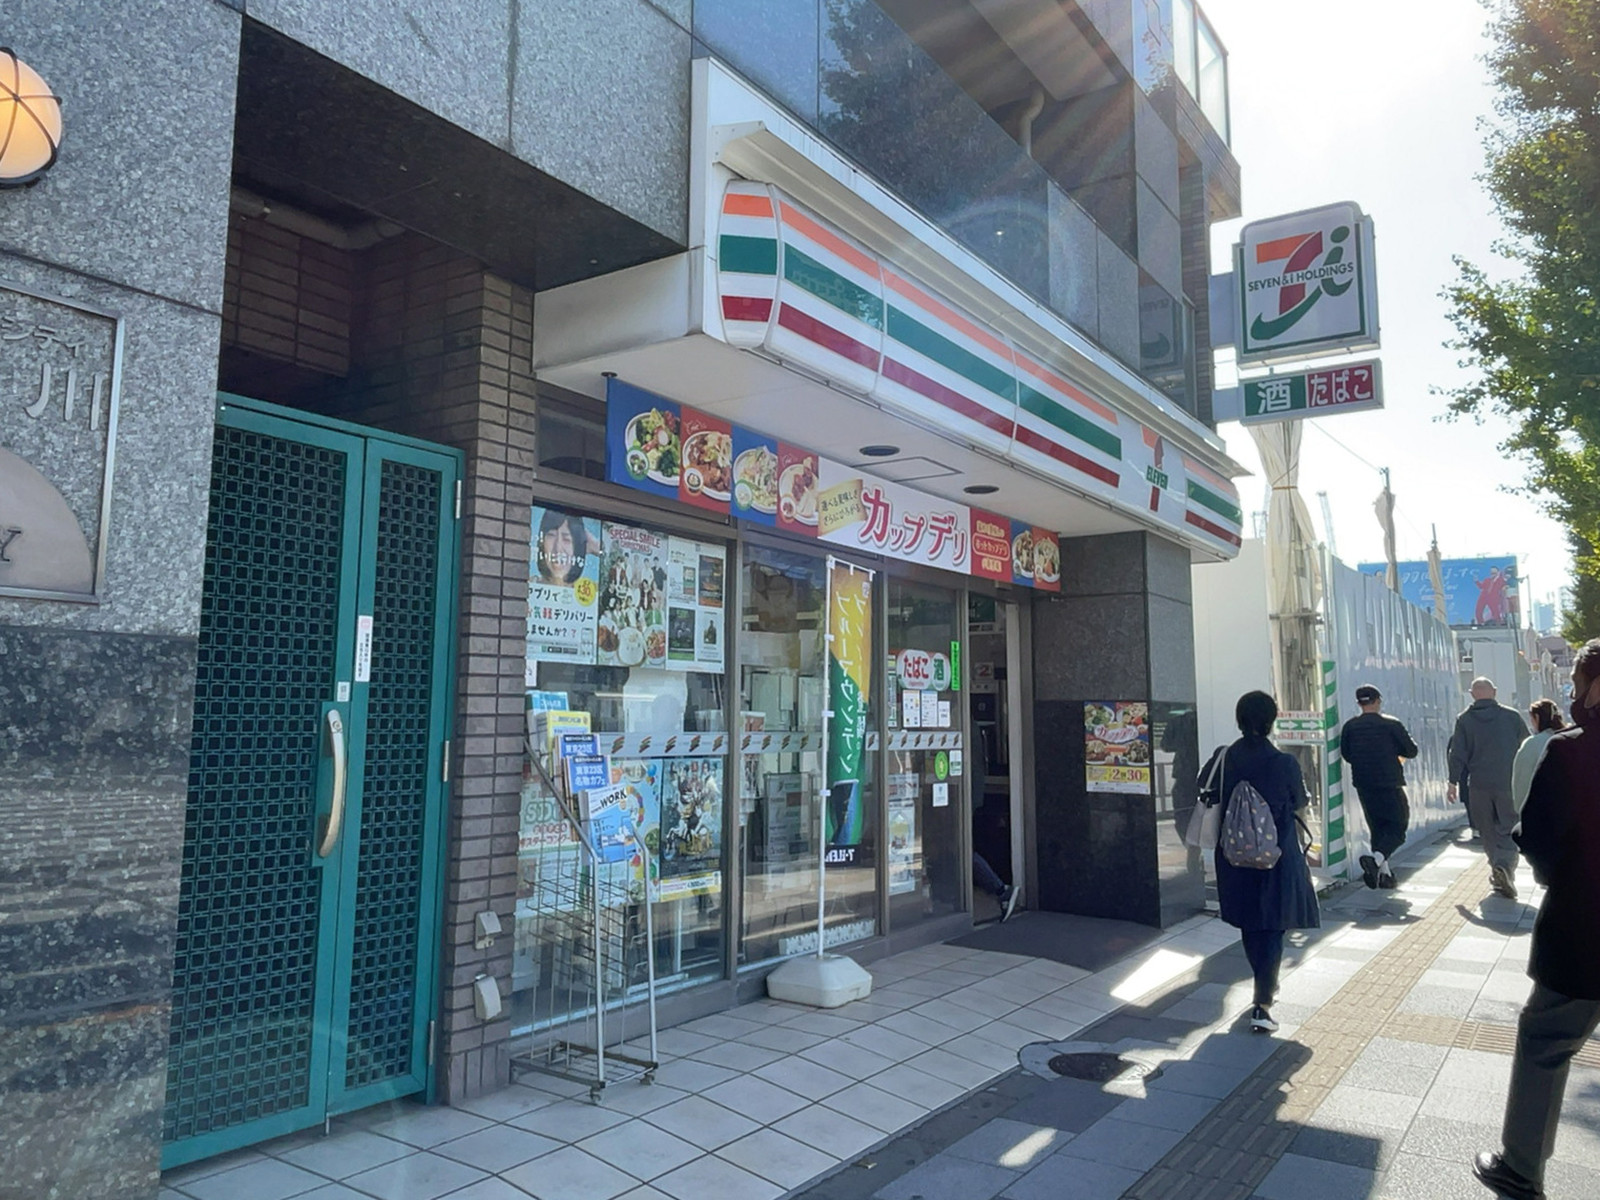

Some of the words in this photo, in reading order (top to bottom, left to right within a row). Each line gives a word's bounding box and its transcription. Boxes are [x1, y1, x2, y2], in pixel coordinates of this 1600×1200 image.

[1296, 262, 1354, 283] HOLDINGS
[1257, 378, 1291, 414] 酒
[1310, 369, 1371, 407] たばこ
[860, 488, 967, 562] カップデリ
[609, 528, 638, 542] SPECIAL
[639, 533, 661, 548] SMILE
[903, 655, 929, 680] たばこ
[600, 788, 627, 807] WORK
